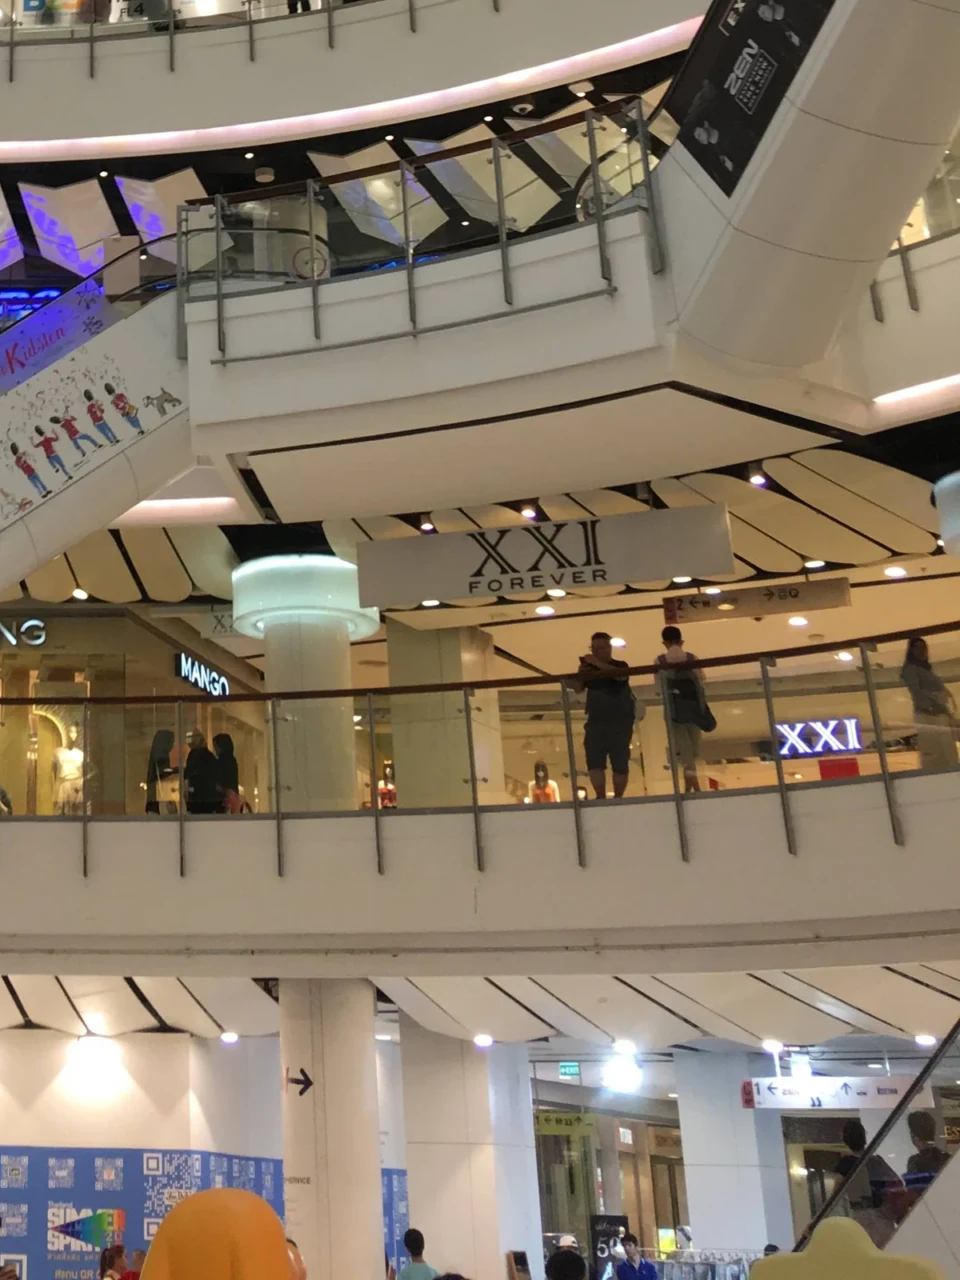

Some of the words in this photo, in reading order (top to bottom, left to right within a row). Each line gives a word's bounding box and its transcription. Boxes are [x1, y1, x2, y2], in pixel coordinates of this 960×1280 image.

[723, 37, 760, 96] ZEN
[4, 326, 66, 374] Kidston
[467, 519, 606, 578] XXI
[468, 568, 608, 594] FOREVER
[180, 652, 230, 696] MANGO
[775, 718, 862, 755] XXI
